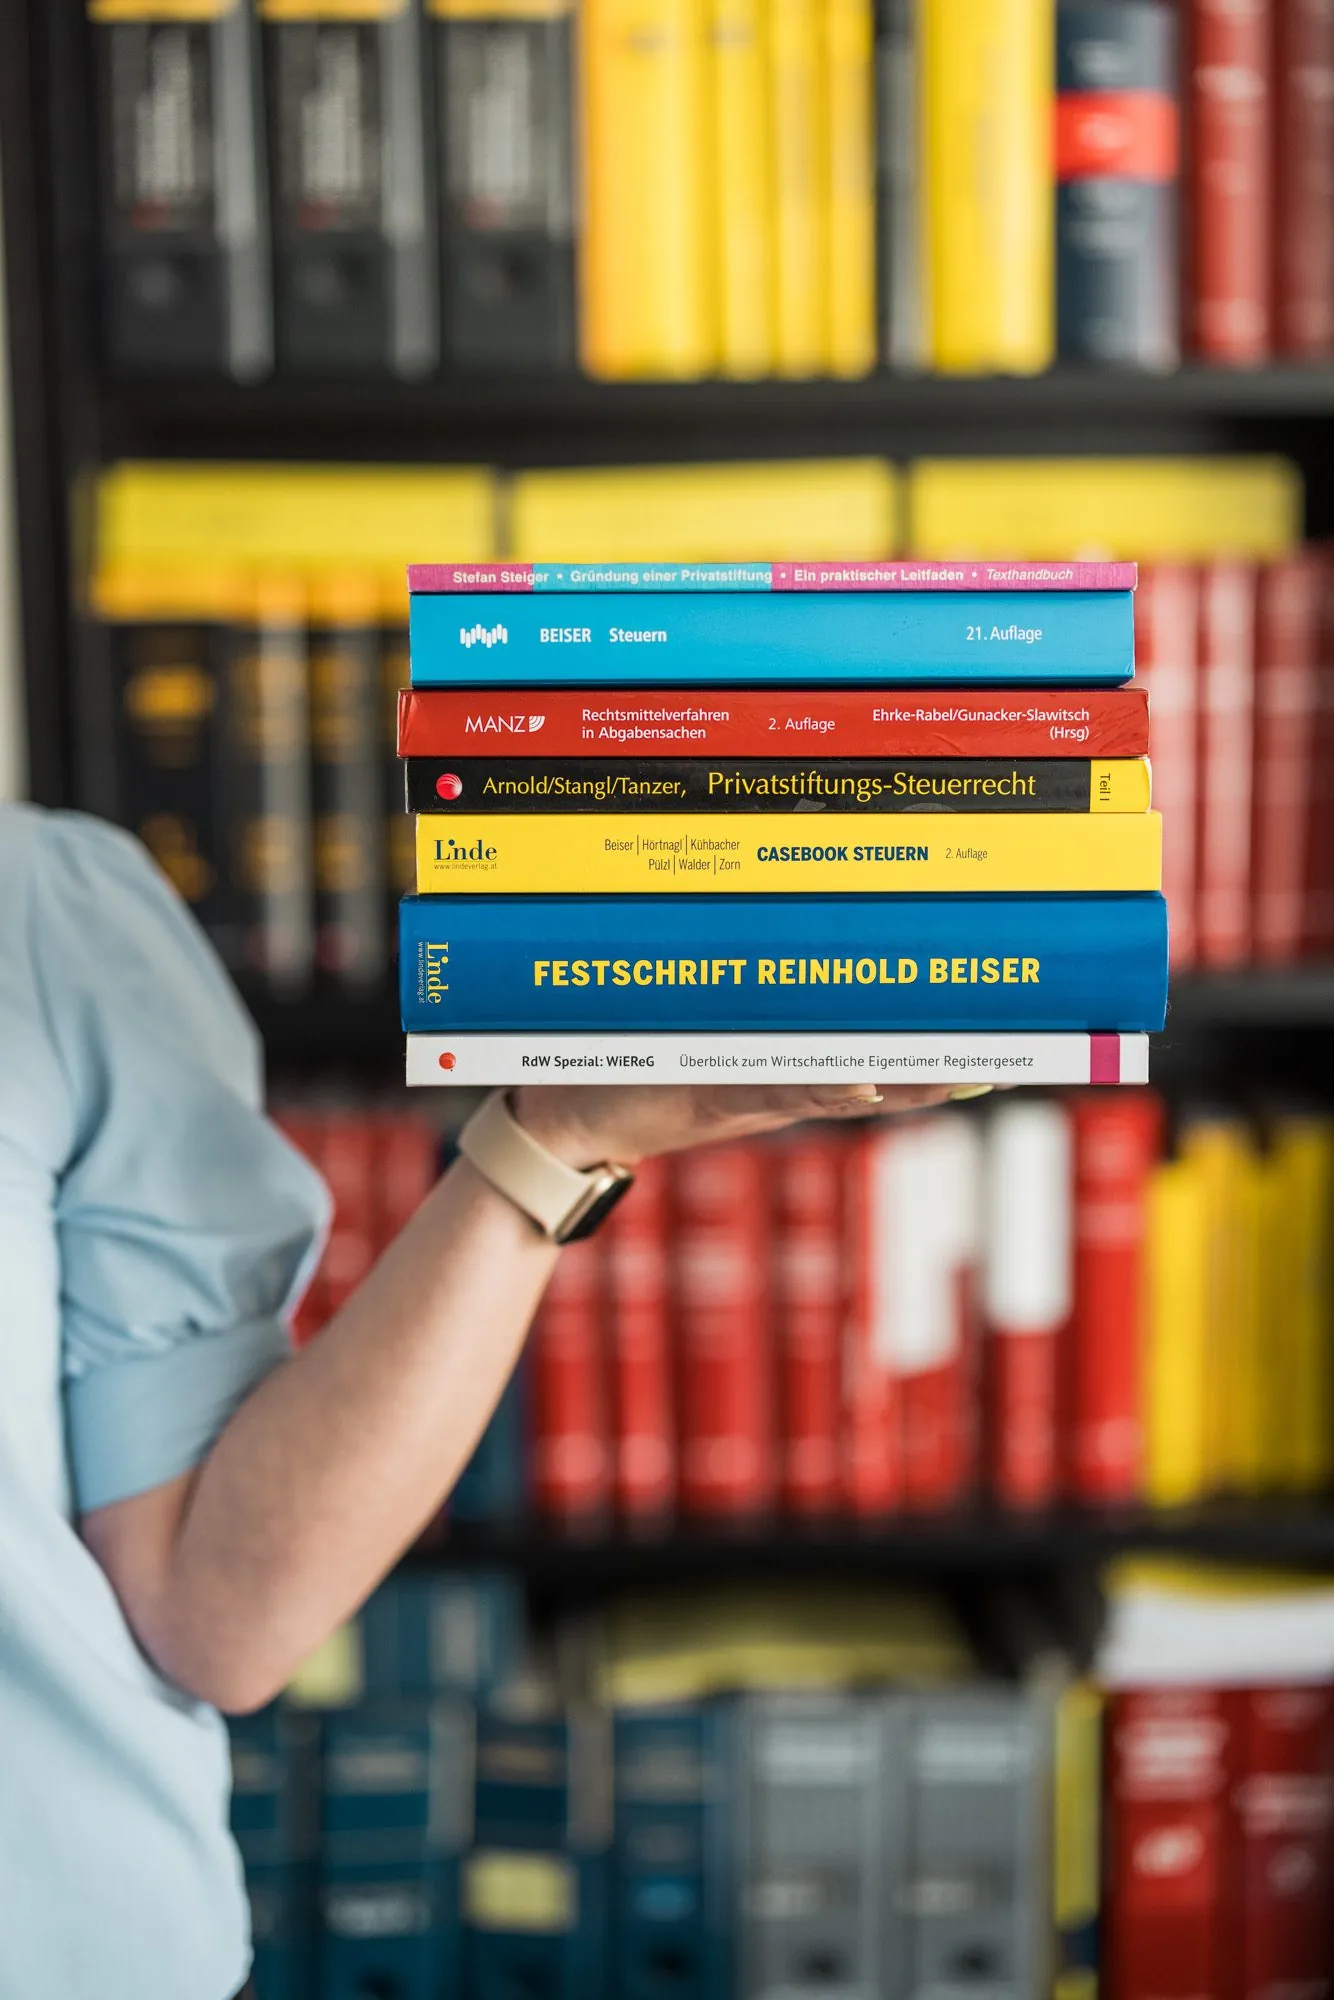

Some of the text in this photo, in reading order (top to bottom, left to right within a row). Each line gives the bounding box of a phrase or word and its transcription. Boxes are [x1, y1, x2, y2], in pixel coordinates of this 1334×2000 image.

[453, 568, 1074, 585] Stefan Steiger Gründung einer Privatstiftung Ein praktischer Leitfaden Texthandbuch
[540, 627, 667, 643] BEISER Steuern
[990, 625, 1043, 644] Auflage
[581, 708, 730, 722] Rechtsmittelverfahren
[872, 708, 1090, 722] Ehrke-Rabel/Gunacker-Slawitsch
[465, 715, 525, 733] MANZ
[768, 717, 835, 734] 2. Auflage
[581, 726, 706, 742] in Abgabensachen
[1049, 726, 1090, 741] (Hrsg)
[483, 770, 1036, 802] Arnold/Stangl/Tanzer, Privatstiftungs-Steuerrecht
[1099, 772, 1111, 794] Teil
[433, 838, 498, 861] Linde
[604, 838, 634, 851] Beiser
[690, 838, 740, 851] Kühbacher
[756, 846, 929, 862] CASEBOOK STEUERN
[945, 847, 988, 861] 2. Auflage
[678, 858, 711, 871] Walder
[719, 858, 741, 871] Zorn
[427, 941, 449, 1004] Linde
[533, 957, 1040, 987] FESTSCHRIFT REINHOLD BEISER
[521, 1055, 655, 1070] RdW Spezial: WiEReG
[679, 1053, 1034, 1070] Überblick zum Wirtschaftliche Eigentümer Registergesetz
